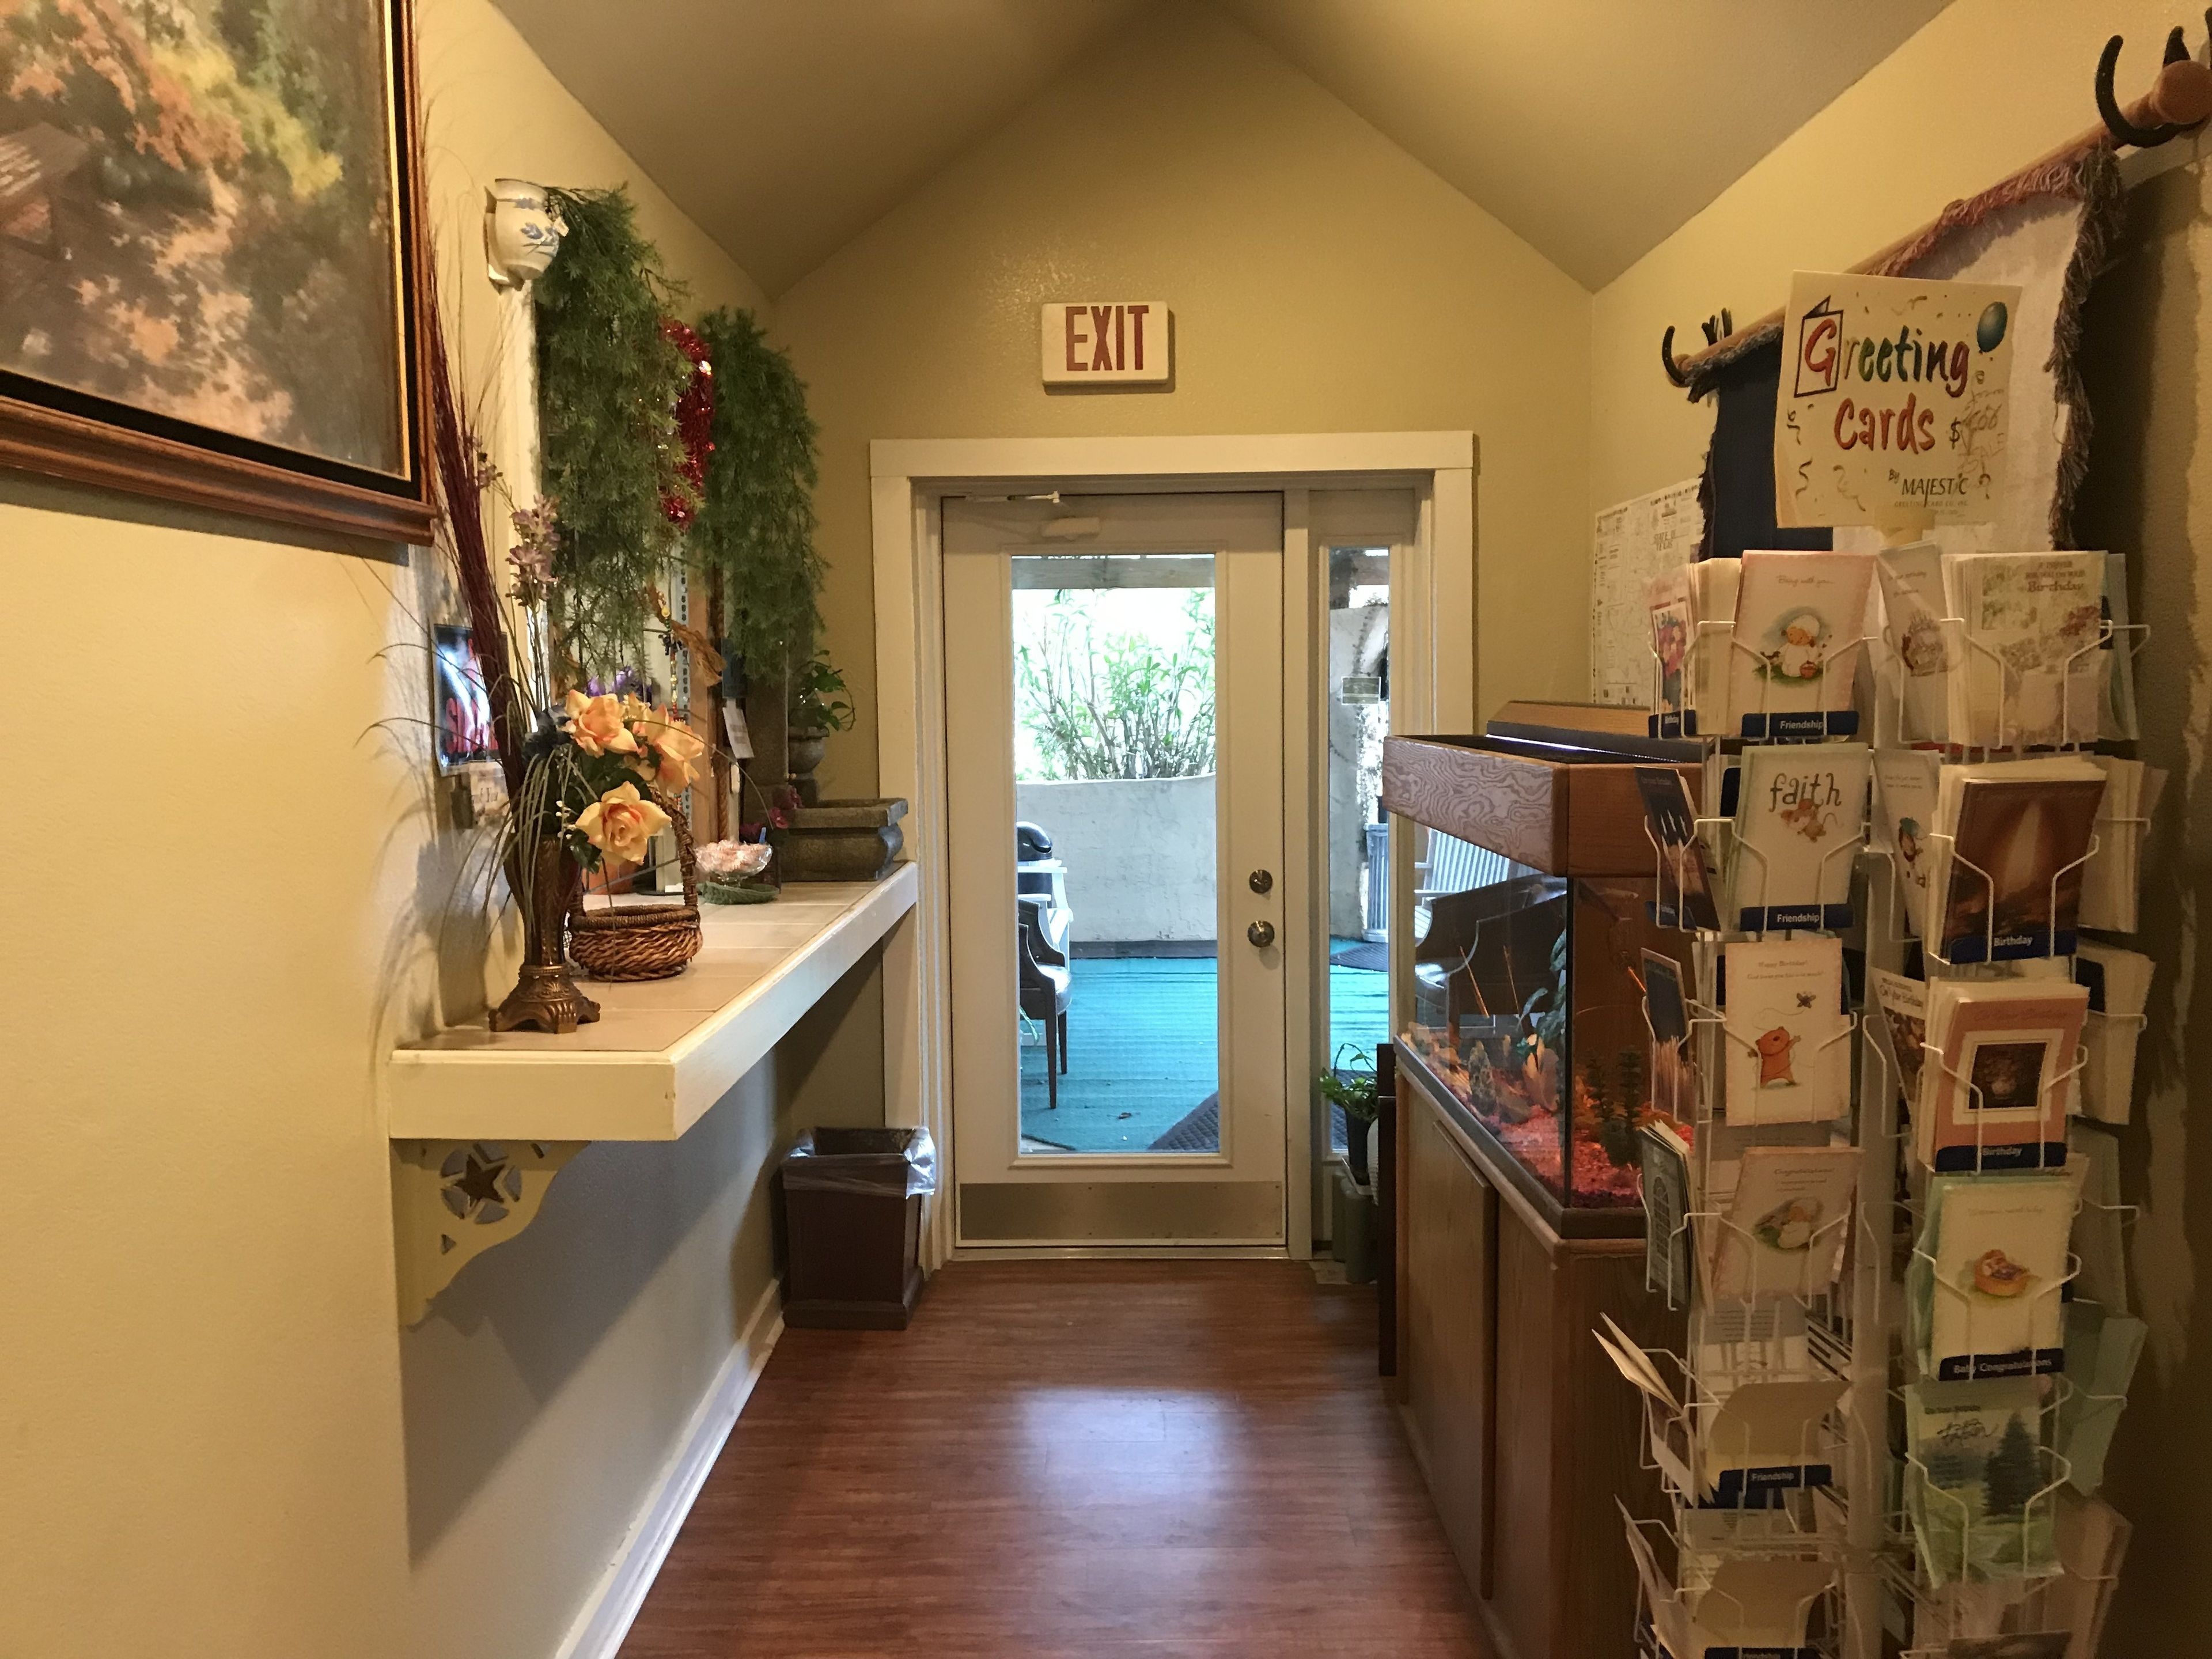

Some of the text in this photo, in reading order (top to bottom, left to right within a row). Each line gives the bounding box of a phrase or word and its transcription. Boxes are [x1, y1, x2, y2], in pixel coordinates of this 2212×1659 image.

[1066, 305, 1149, 371] EXIT
[1805, 318, 1970, 397] Greeting
[1834, 392, 1936, 454] Cards
[1889, 468, 1900, 483] By
[1902, 478, 1968, 506] MAJESTIC
[1780, 719, 1824, 730] Friendship
[1769, 772, 1842, 812] faith
[1777, 912, 1820, 923] Friendship
[1994, 935, 2033, 946] Birthday
[1982, 1147, 2022, 1157] Birthday
[1752, 1472, 1793, 1481] Friendship
